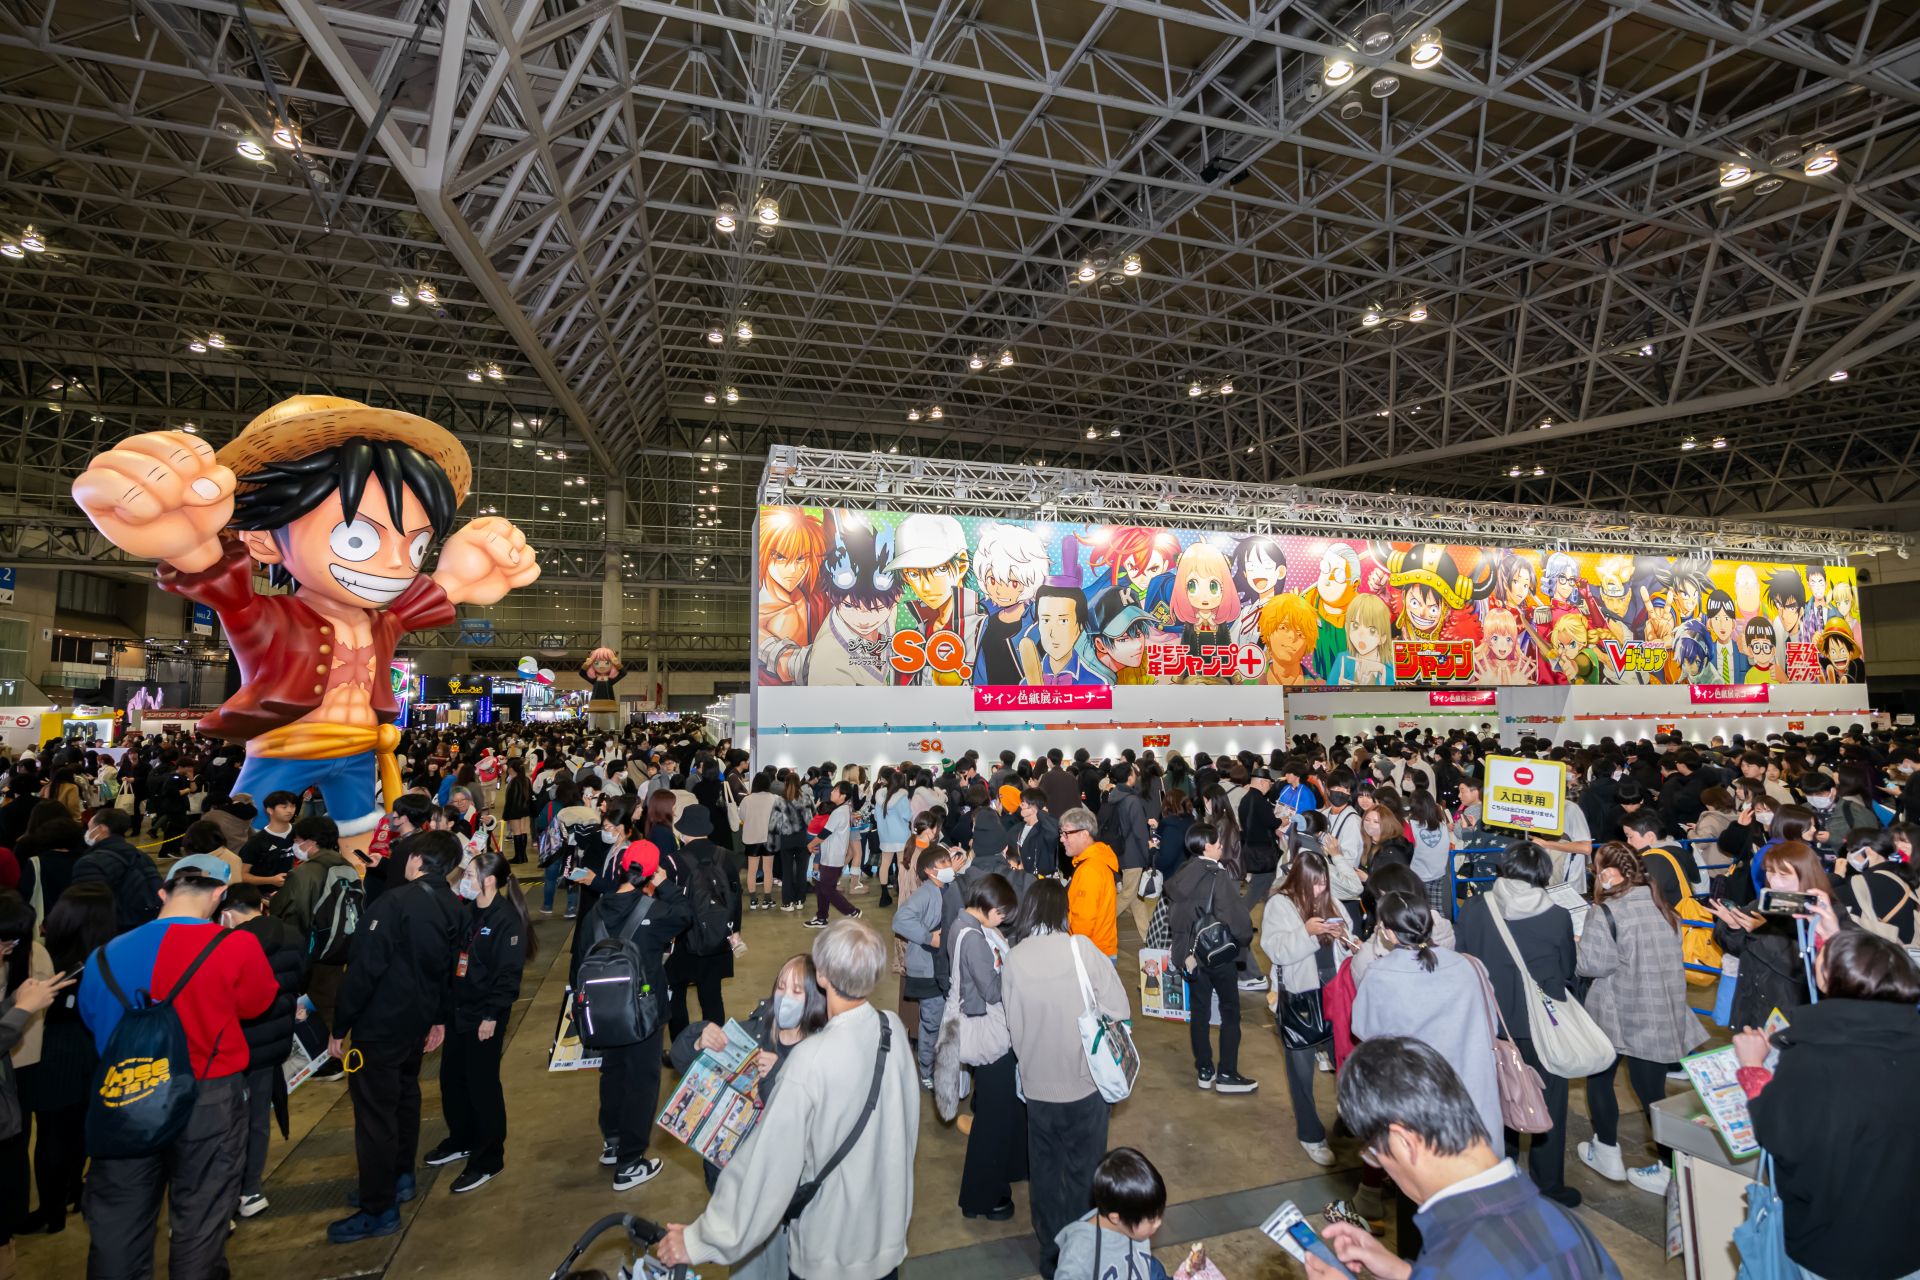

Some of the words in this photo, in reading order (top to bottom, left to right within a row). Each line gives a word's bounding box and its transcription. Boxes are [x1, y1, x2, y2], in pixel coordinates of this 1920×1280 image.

[1118, 587, 1135, 606] K
[848, 637, 892, 652] ジャンプ
[1389, 641, 1473, 680] ジャンプ
[1787, 642, 1820, 666] 最強
[1787, 667, 1821, 682] ジャンプ
[982, 692, 1106, 705] サイン色紙展示コーナー
[1500, 791, 1546, 807] 入口専用
[1491, 804, 1555, 819] こちらは出口ではありません
